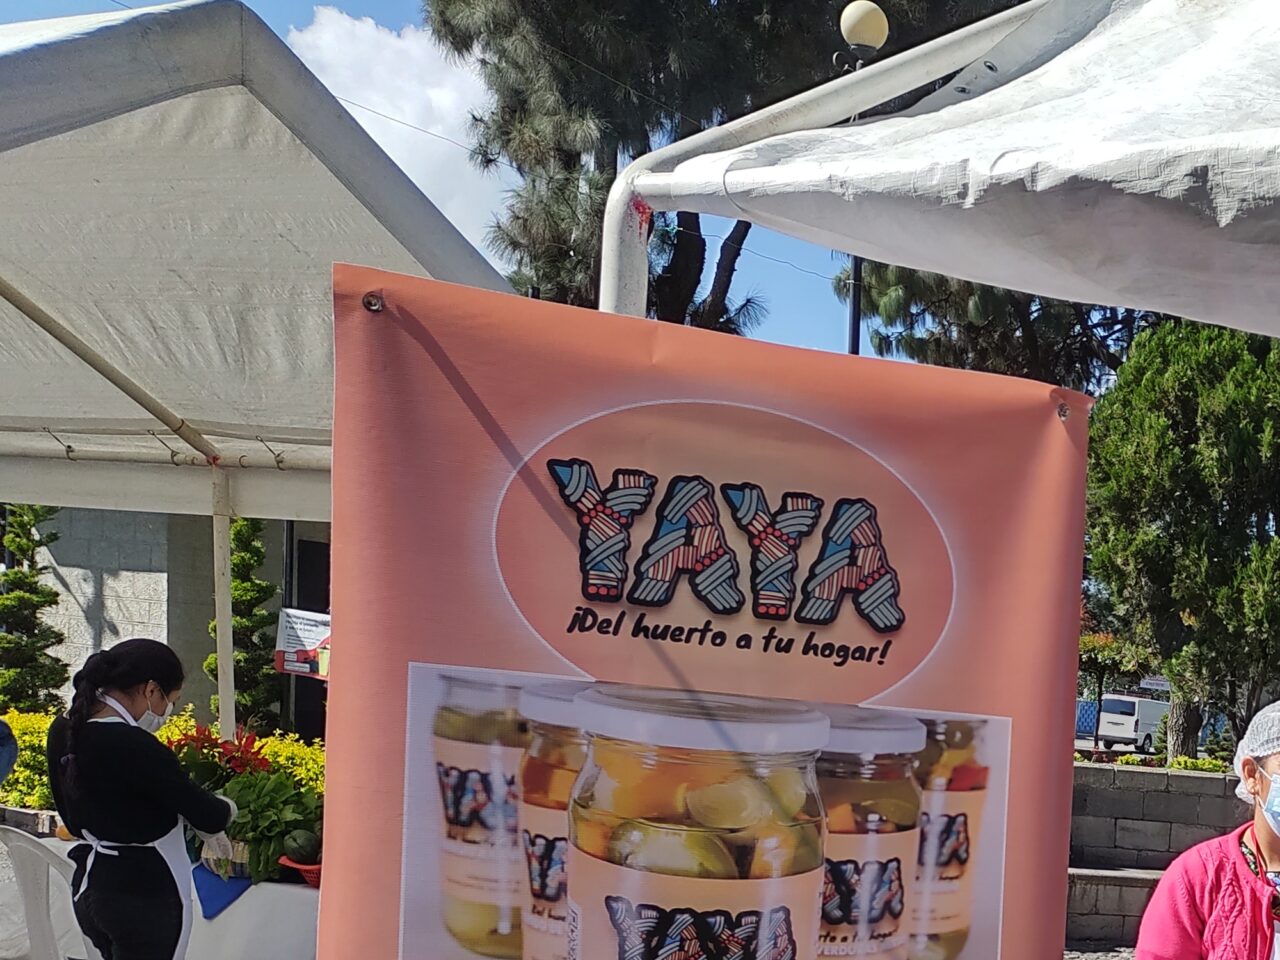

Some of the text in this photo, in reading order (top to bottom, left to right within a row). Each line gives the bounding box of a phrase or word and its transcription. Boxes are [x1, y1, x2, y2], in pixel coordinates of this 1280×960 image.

[547, 458, 905, 634] YAYA
[631, 616, 727, 647] huerto
[736, 631, 752, 650] a
[762, 627, 794, 654] tu
[802, 632, 893, 667] hogar!
